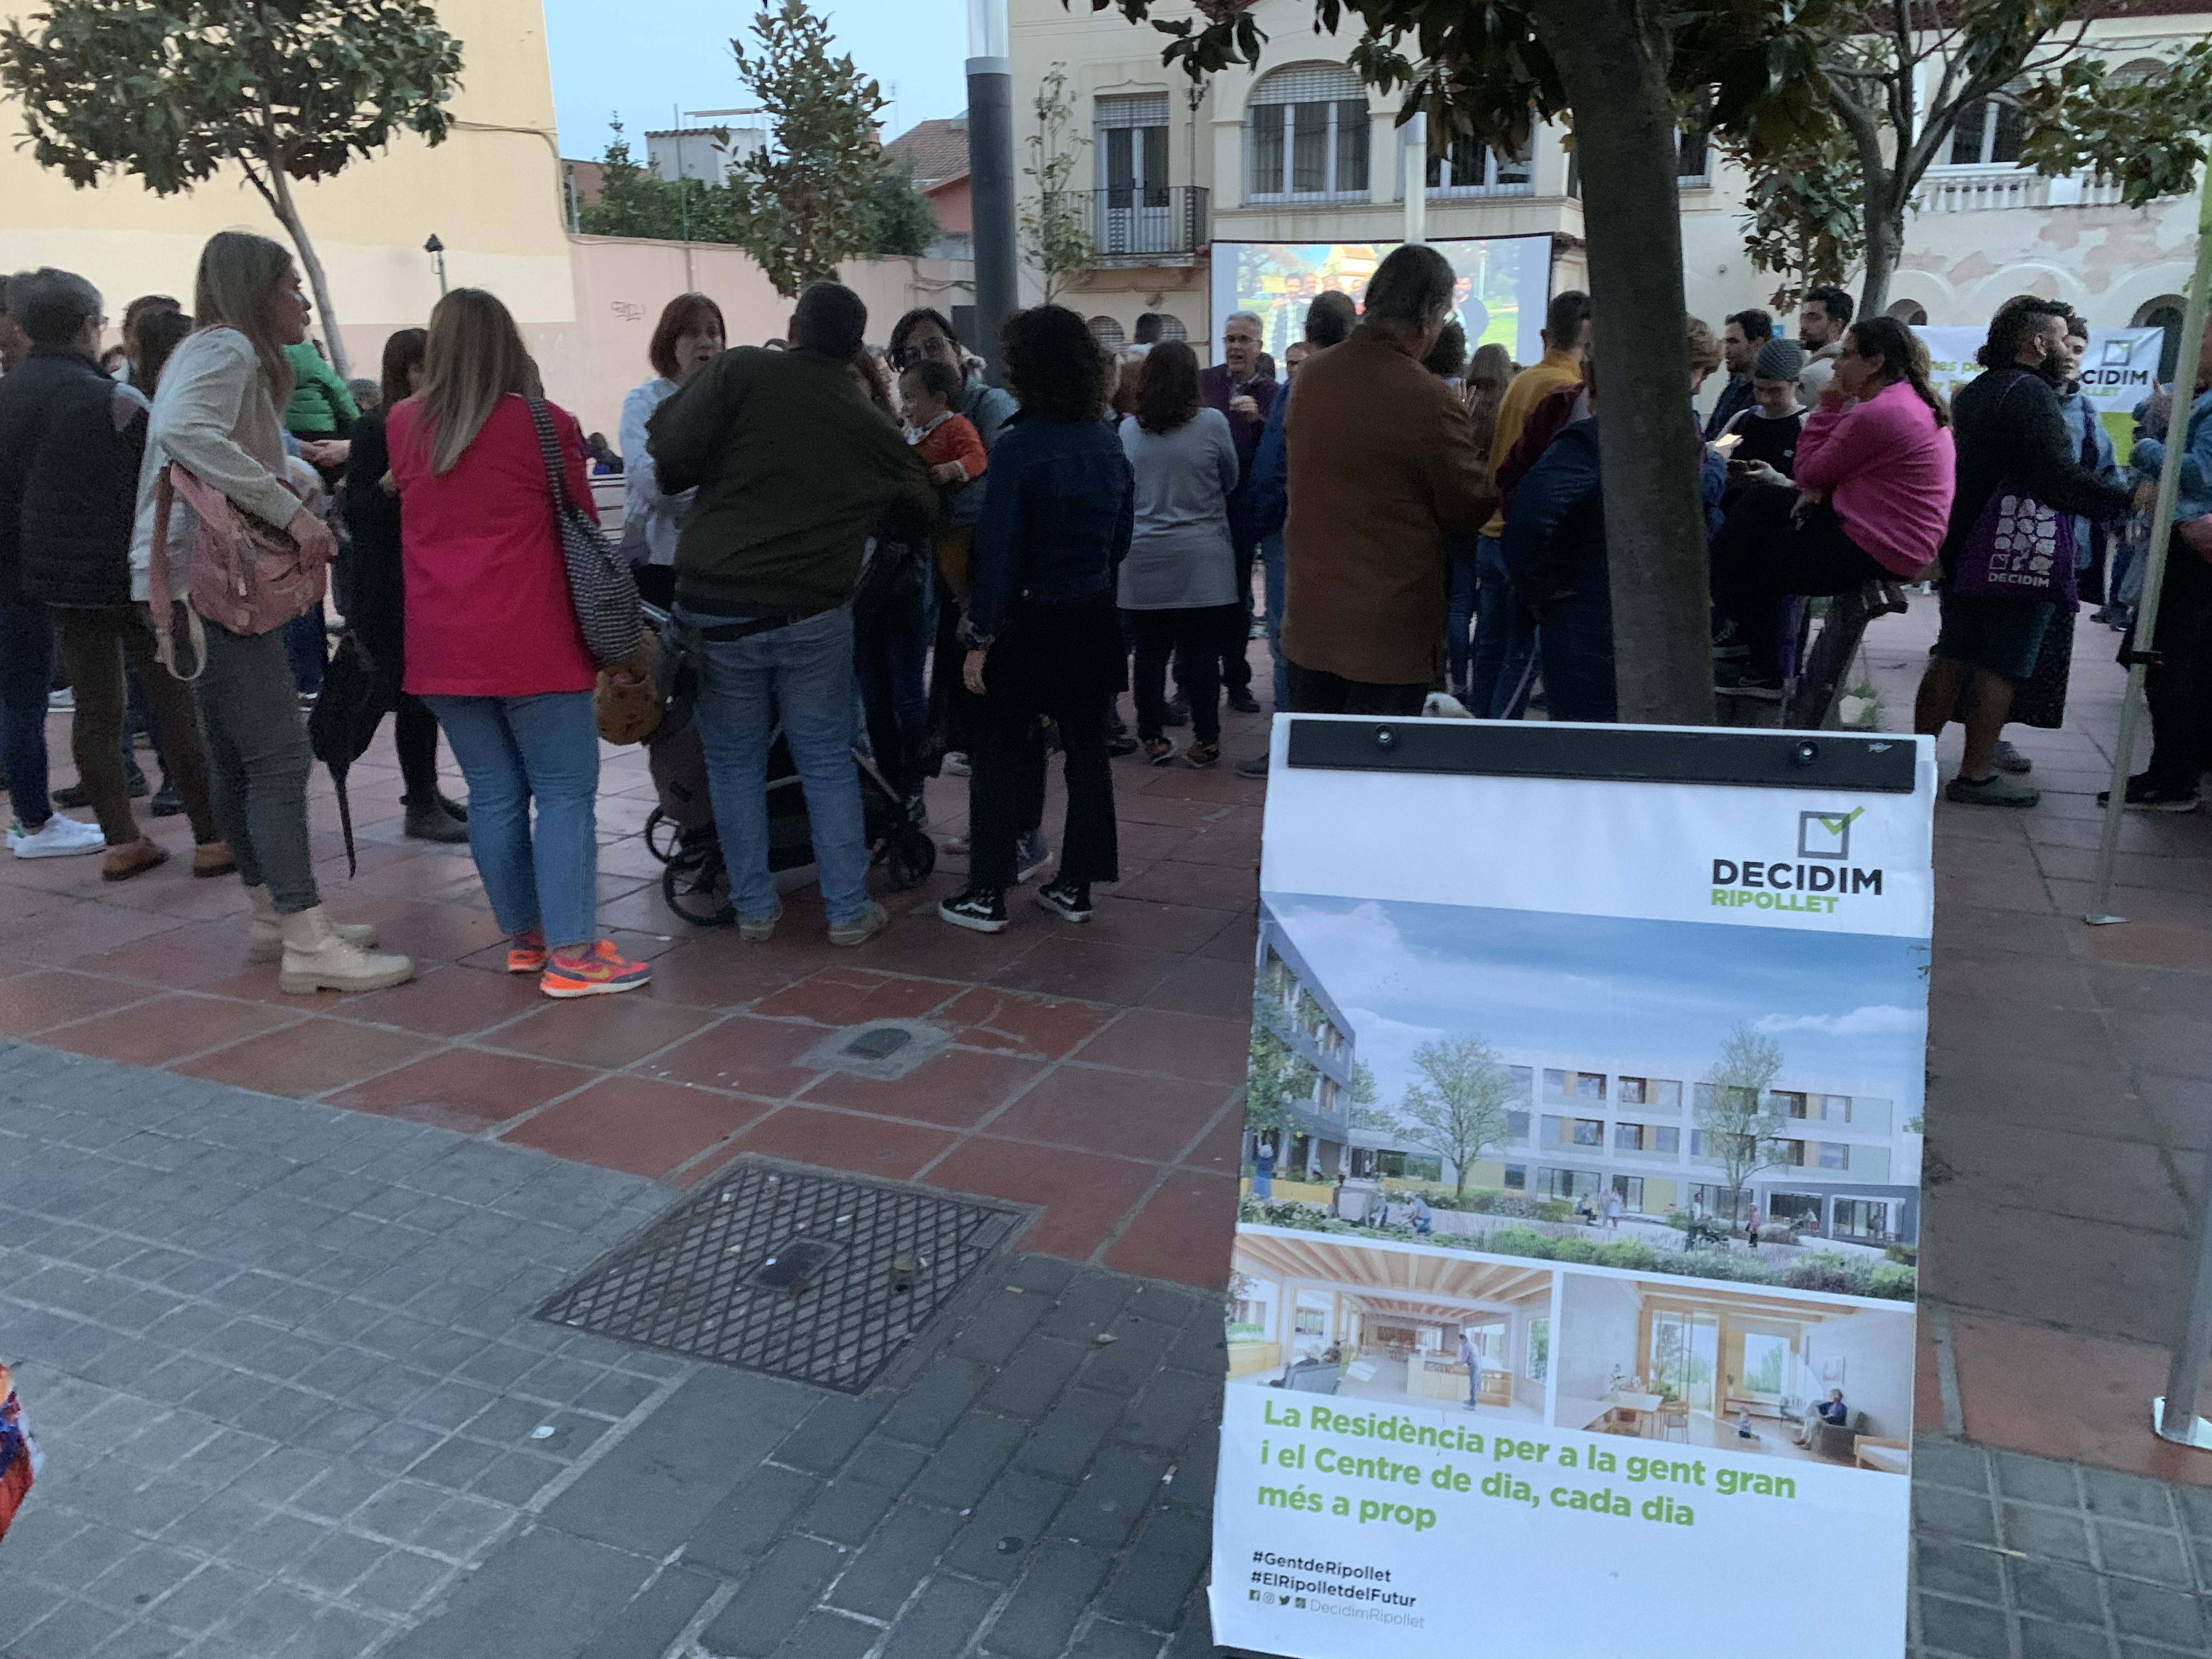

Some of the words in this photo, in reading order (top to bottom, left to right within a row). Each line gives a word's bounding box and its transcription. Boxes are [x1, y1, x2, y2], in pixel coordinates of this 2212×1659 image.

[2080, 369, 2149, 385] CIDIM
[1988, 572, 2050, 588] DECIDIM
[1712, 859, 1883, 896] DECIDIM
[1711, 888, 1839, 914] RIPOLLET
[1264, 1400, 1301, 1427] La
[1310, 1406, 1485, 1453] Residència
[1493, 1437, 1550, 1462] per
[1558, 1446, 1578, 1468] a
[1588, 1444, 1616, 1473] la
[1626, 1455, 1706, 1486] gent
[1716, 1468, 1796, 1499] gran
[1261, 1440, 1269, 1465] i
[1278, 1443, 1306, 1469] el
[1314, 1447, 1421, 1485] Centre
[1430, 1464, 1471, 1493] de
[1481, 1471, 1540, 1508] dia,
[1550, 1487, 1632, 1517] cada
[1641, 1496, 1694, 1526] dia
[1257, 1483, 1323, 1513] més
[1331, 1496, 1350, 1516] a
[1358, 1499, 1437, 1532] prop
[1252, 1550, 1391, 1583] #GentdeRipollet
[1251, 1571, 1417, 1607] #ElRipolletdelFutur
[1310, 1599, 1425, 1629] DecidimRipollet
